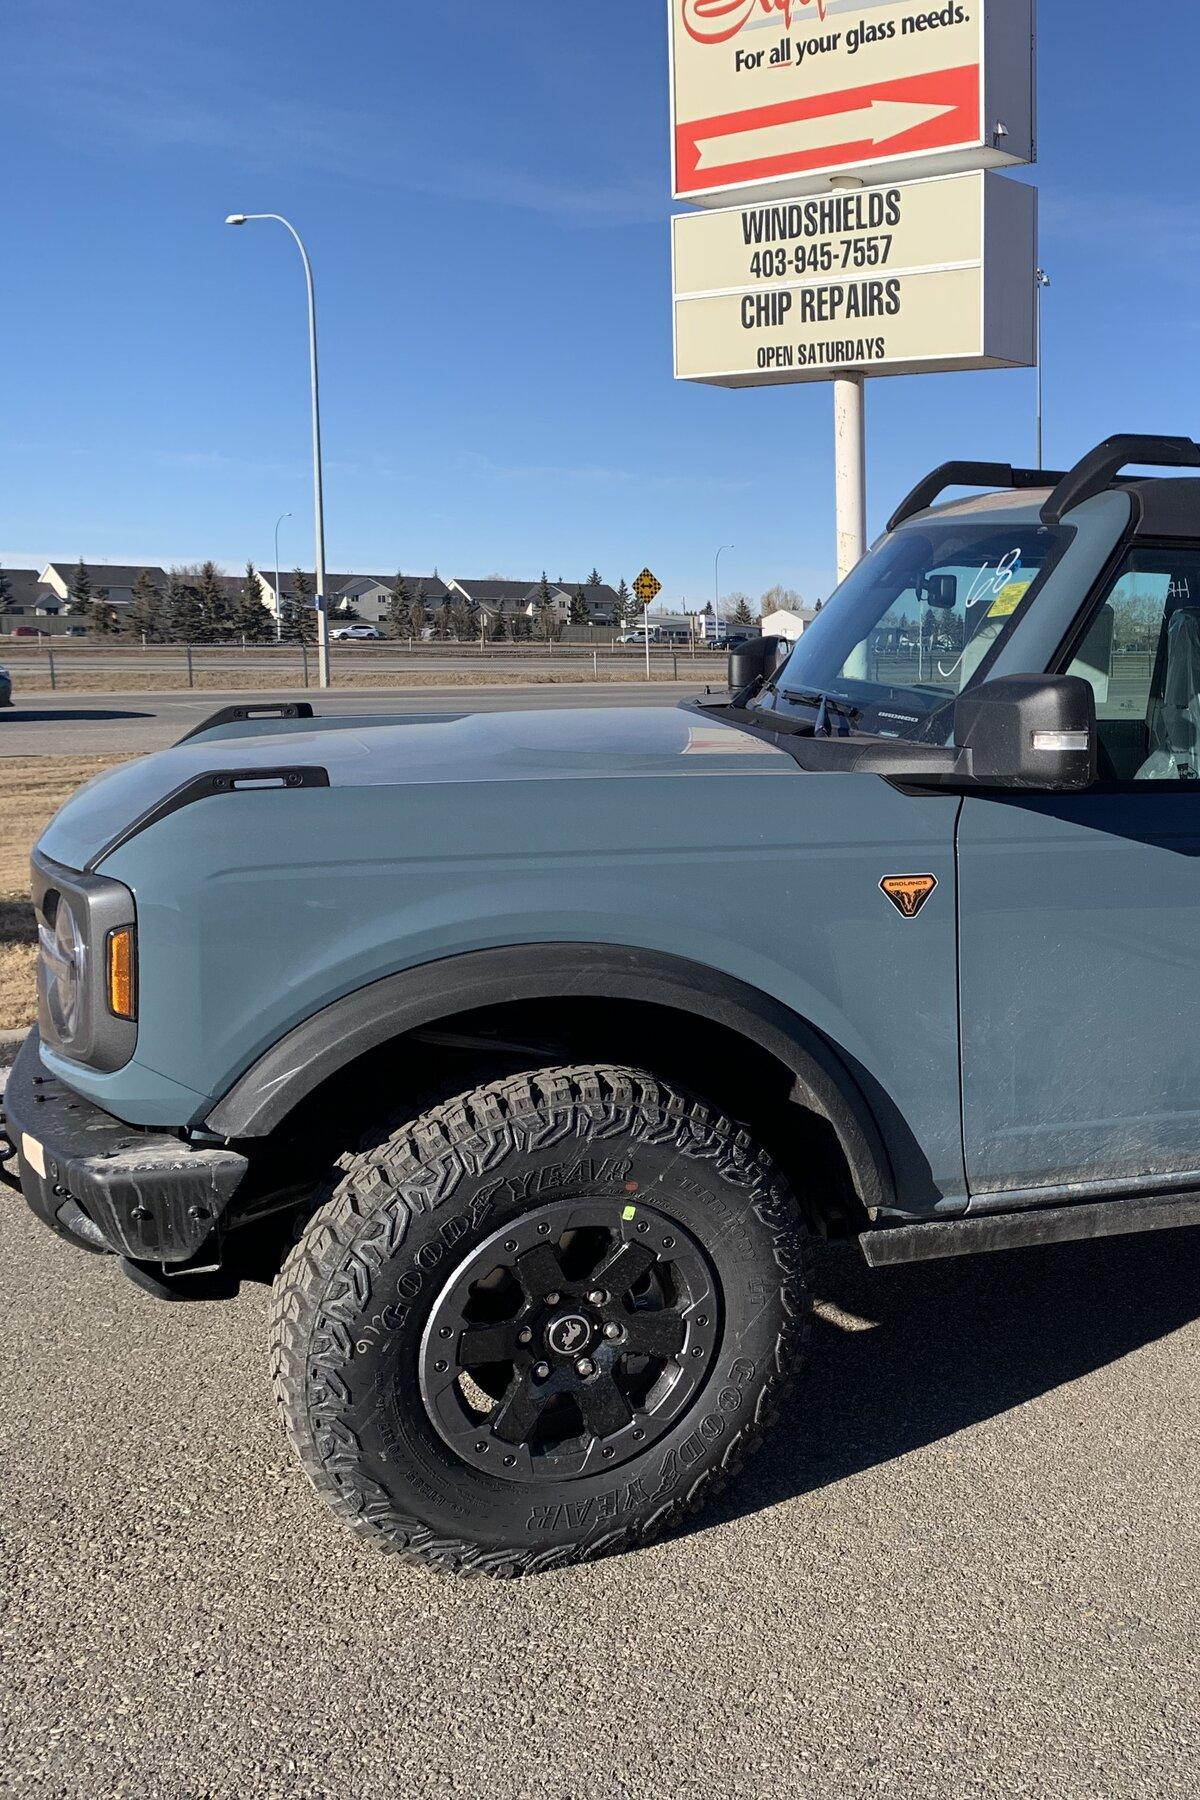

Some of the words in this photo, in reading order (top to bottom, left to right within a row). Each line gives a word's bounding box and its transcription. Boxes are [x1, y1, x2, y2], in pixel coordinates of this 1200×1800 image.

[735, 50, 764, 72] For
[769, 38, 791, 64] all
[795, 32, 841, 66] your
[845, 19, 895, 54] glass
[901, 1, 970, 35] needs.
[741, 189, 901, 245] WINDSHIELDS
[750, 235, 892, 279] 403-945-7557
[741, 291, 792, 329] CHIP
[801, 279, 900, 323] REPAIRS
[757, 345, 793, 368] OPEN
[798, 337, 885, 365] SATURDAYS
[380, 1157, 634, 1332] GOODYEAR
[525, 1356, 757, 1531] GOODYEAR
